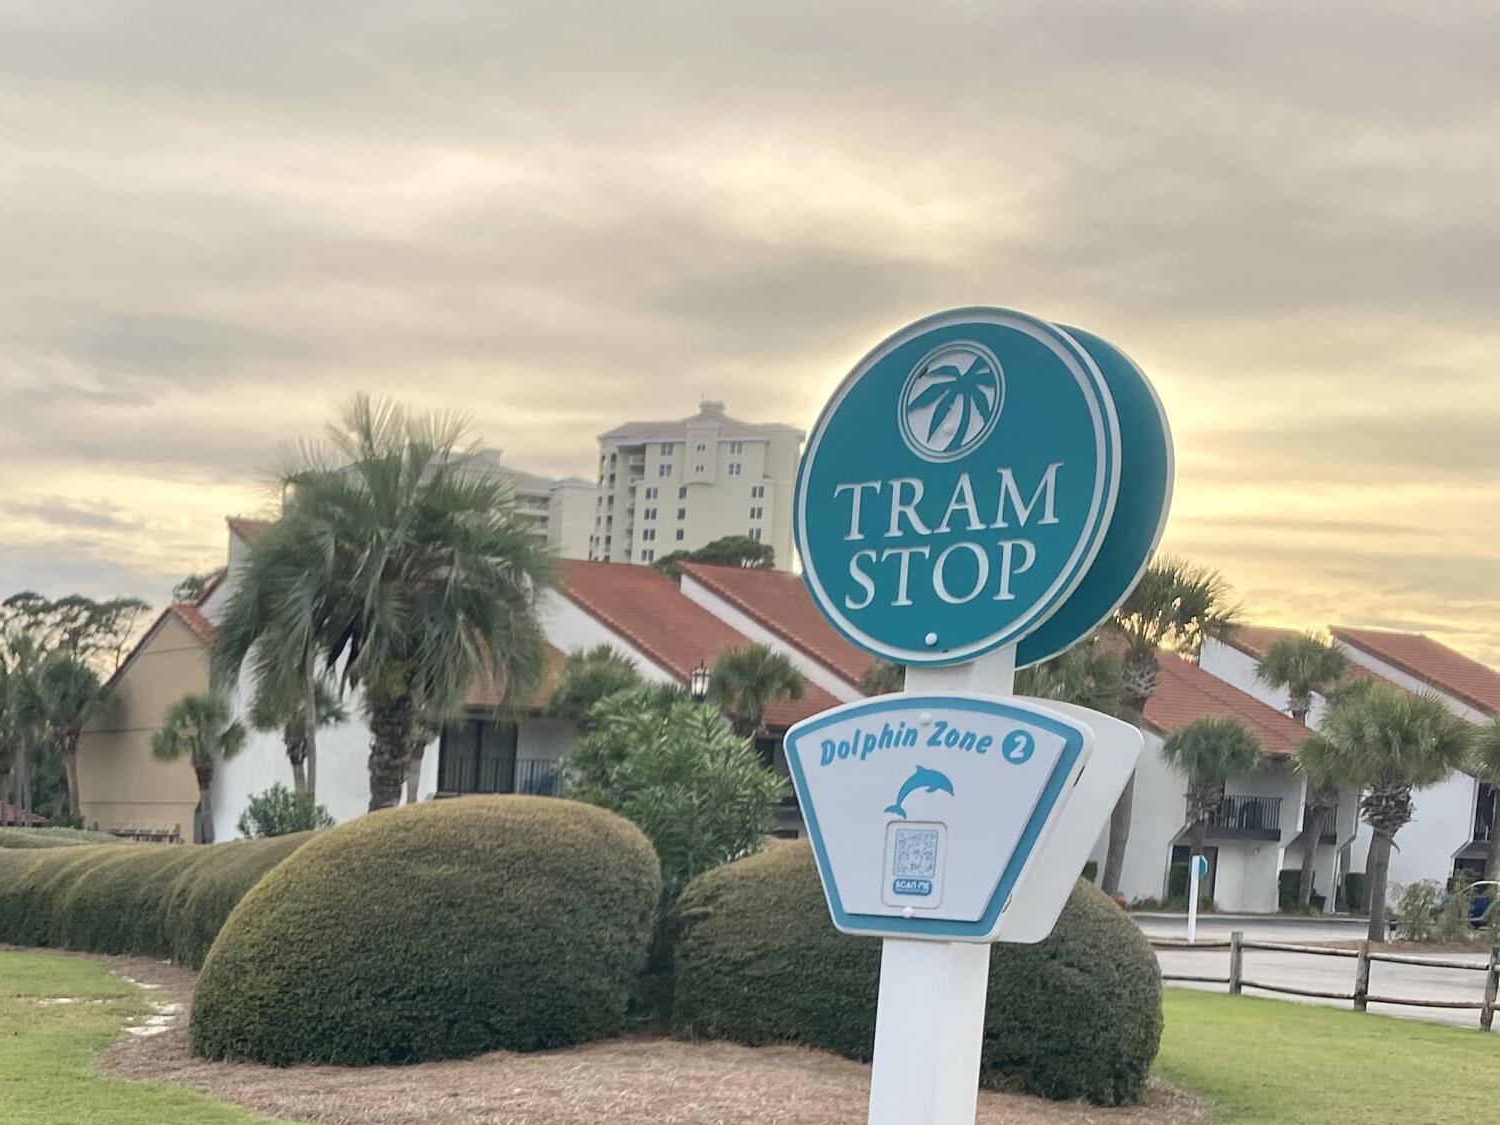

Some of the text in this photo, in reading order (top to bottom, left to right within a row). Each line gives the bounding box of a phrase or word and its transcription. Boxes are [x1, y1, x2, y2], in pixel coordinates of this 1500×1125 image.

[833, 462, 1065, 541] TRAM
[844, 539, 1037, 610] STOP
[819, 721, 1028, 766] Dolphin Zone 2
